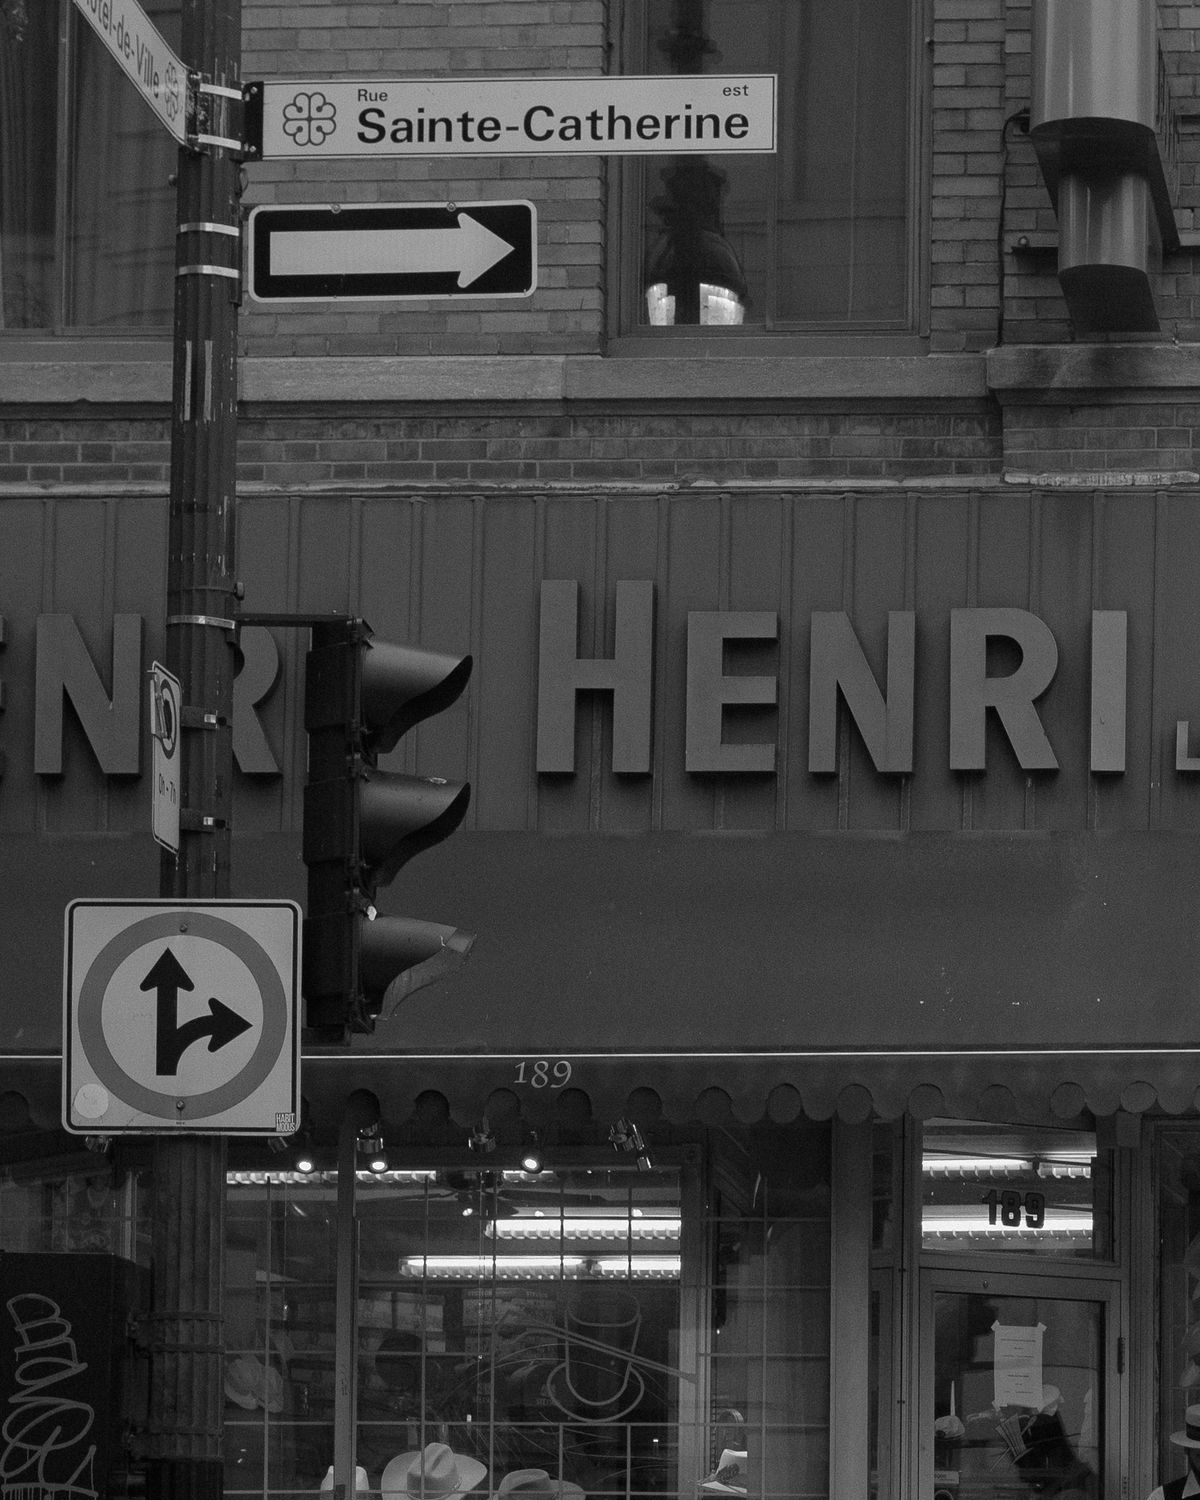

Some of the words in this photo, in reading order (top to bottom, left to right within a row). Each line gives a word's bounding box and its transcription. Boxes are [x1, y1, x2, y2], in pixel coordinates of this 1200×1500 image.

[357, 88, 388, 102] Rue
[722, 84, 749, 97] est
[357, 104, 749, 144] Sainte-Catherine
[537, 579, 1128, 774] HENRI
[513, 1060, 573, 1088] 189
[982, 1189, 1045, 1229] 189
